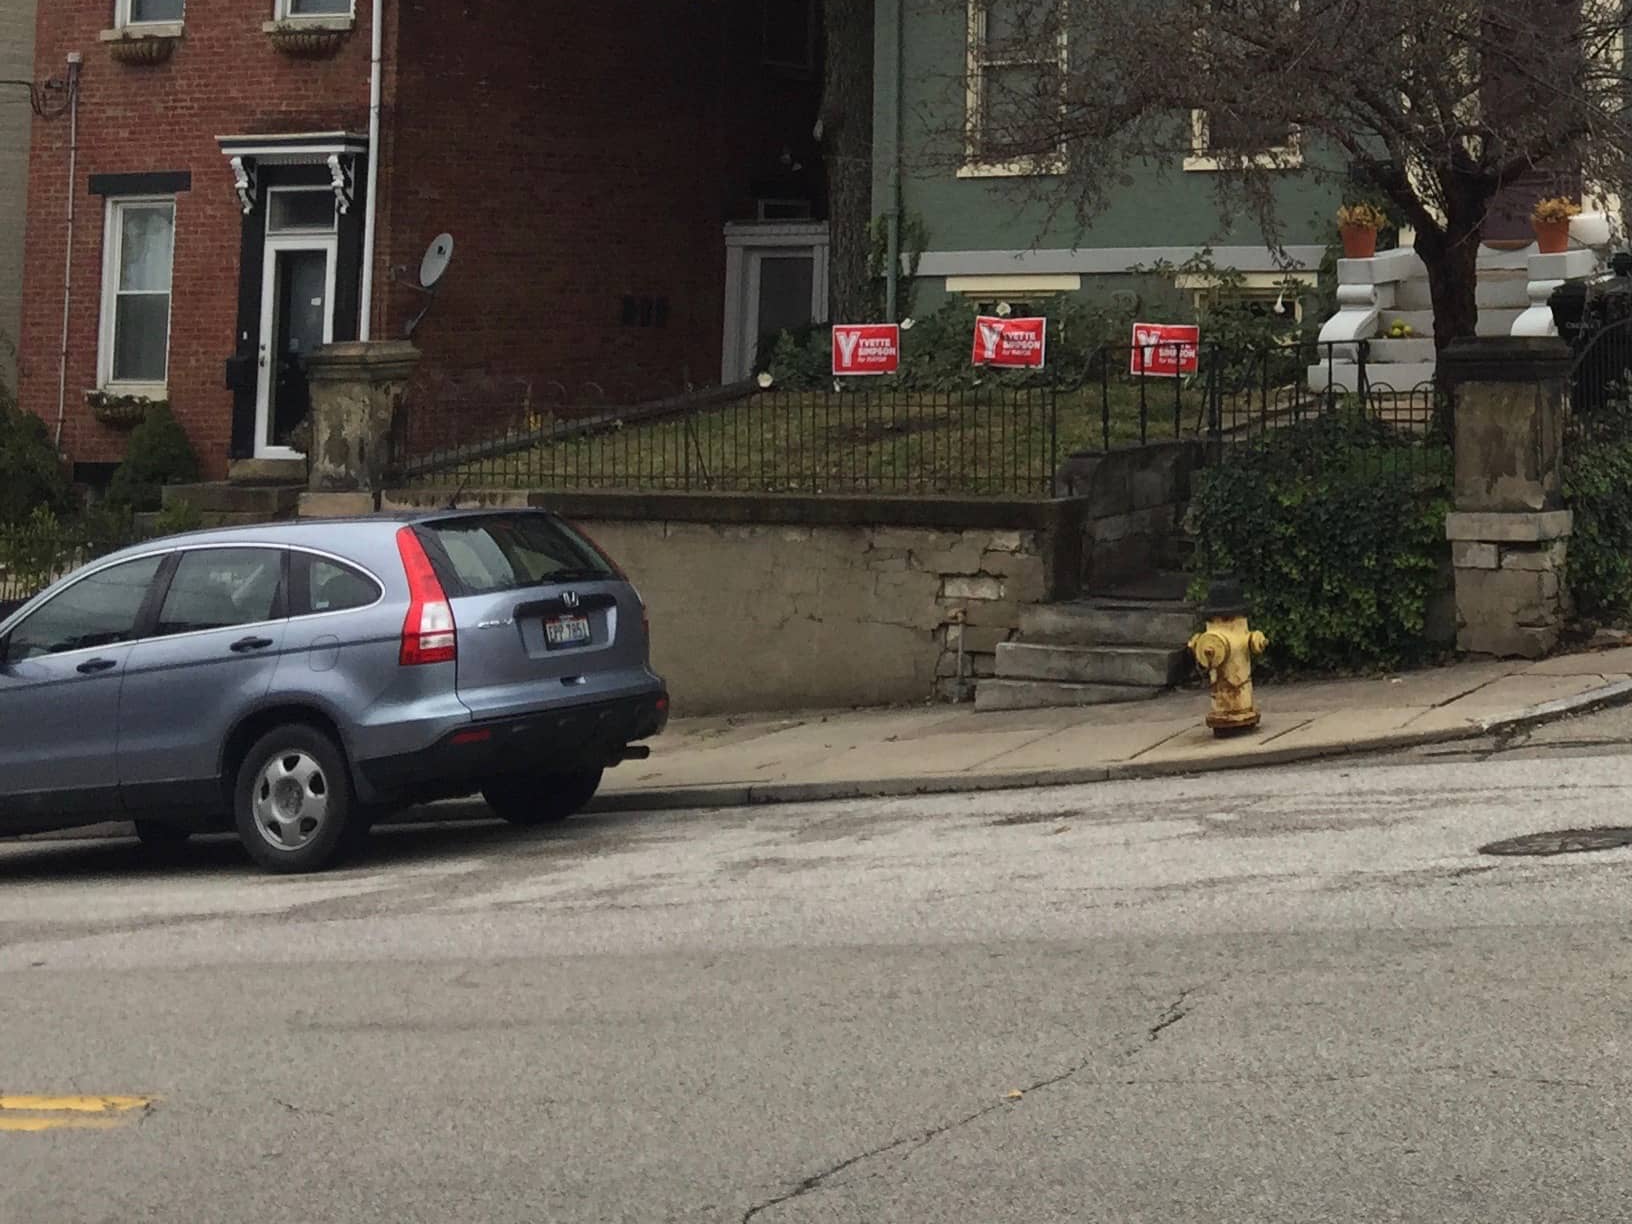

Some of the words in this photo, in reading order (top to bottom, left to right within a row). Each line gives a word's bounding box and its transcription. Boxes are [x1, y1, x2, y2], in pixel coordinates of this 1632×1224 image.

[835, 331, 862, 367] Y
[858, 347, 896, 356] SIMPSON
[859, 338, 891, 347] YVETTE
[979, 323, 1005, 359] Y
